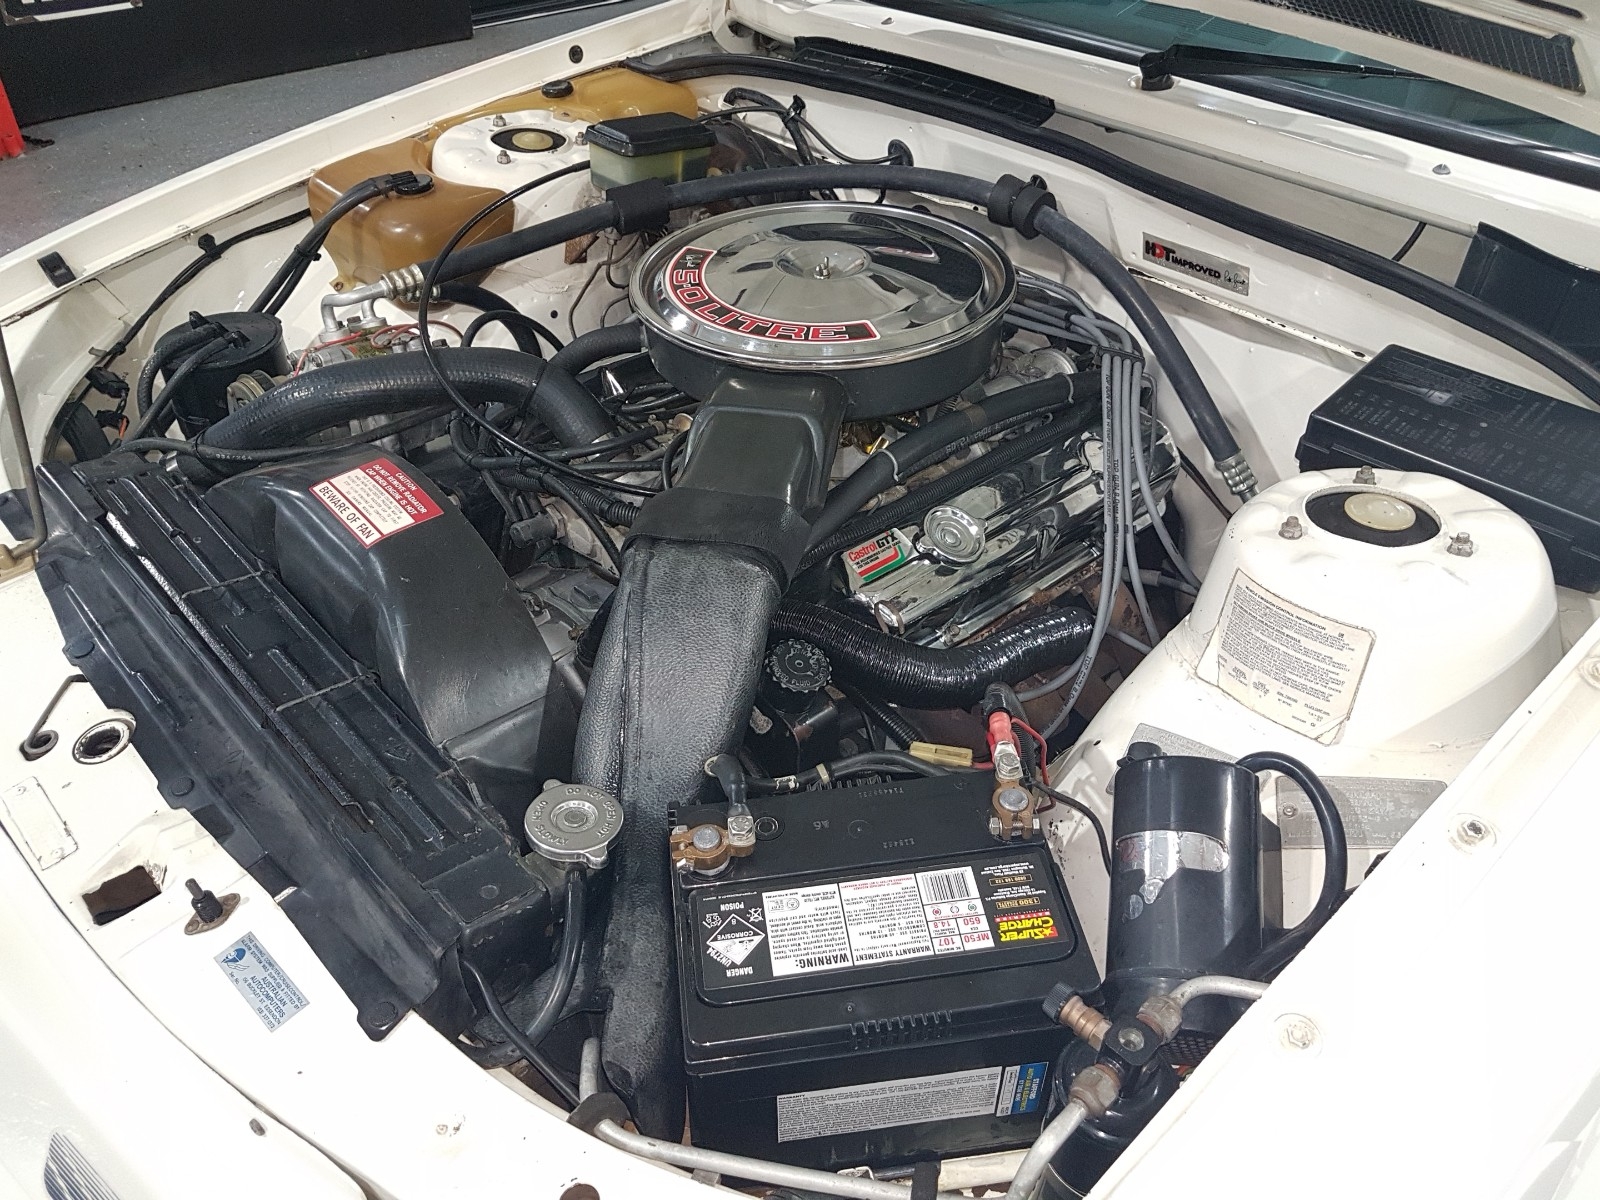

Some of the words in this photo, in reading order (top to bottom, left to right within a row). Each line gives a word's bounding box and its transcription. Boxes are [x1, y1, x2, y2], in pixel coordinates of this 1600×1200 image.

[1171, 255, 1220, 279] IMPROVED
[695, 301, 848, 340] LITRE
[395, 471, 417, 490] CAUTION
[365, 467, 377, 476] CAP
[373, 474, 387, 486] WHEN
[385, 484, 402, 500] ENGINE
[404, 504, 418, 515] HOT
[378, 468, 390, 477] NOT
[387, 475, 405, 491] REMOVE
[403, 490, 427, 513] RADIATOR
[318, 485, 350, 514] BEWARE
[346, 512, 361, 524] OF
[356, 522, 375, 539] FAN
[848, 541, 878, 562] Castrol
[876, 531, 898, 548] GTX
[1275, 605, 1294, 617] CONTROL
[1294, 615, 1326, 631] INFORMATION
[792, 679, 810, 687] FLUID
[566, 787, 581, 795] DO
[585, 789, 606, 800] NOT
[603, 801, 616, 821] OPEN
[597, 822, 613, 838] HOT
[719, 901, 744, 911] POISON
[1018, 897, 1038, 905] 1300
[932, 919, 951, 928] 14.8
[962, 916, 981, 925] 650
[997, 915, 1054, 933] CHARGE
[716, 930, 753, 940] CORROSIVE
[937, 937, 955, 946] 107
[962, 932, 989, 943] MF50
[999, 927, 1044, 943] SUPER
[245, 935, 254, 943] THIS
[252, 943, 265, 956] DRIVING
[894, 944, 931, 956] WARRANTY
[705, 944, 732, 969] UN2794
[794, 952, 849, 967] WARNING:
[854, 950, 893, 961] STATEMENT
[241, 939, 252, 951] ALARM
[251, 951, 263, 964] SYSTEM
[261, 964, 269, 972] WAS
[267, 971, 282, 989] SUPPLIED
[284, 991, 295, 1005] FITTED
[725, 965, 753, 977] DANGER
[250, 975, 286, 1018] AUTOCOMPUTERS
[261, 976, 288, 1007] AUSTRALIAN
[247, 982, 261, 998] BUCKLEY
[263, 1004, 281, 1025] ESSENDON
[1026, 1068, 1034, 1079] AUTO
[1029, 1078, 1039, 1099] STAFFORD
